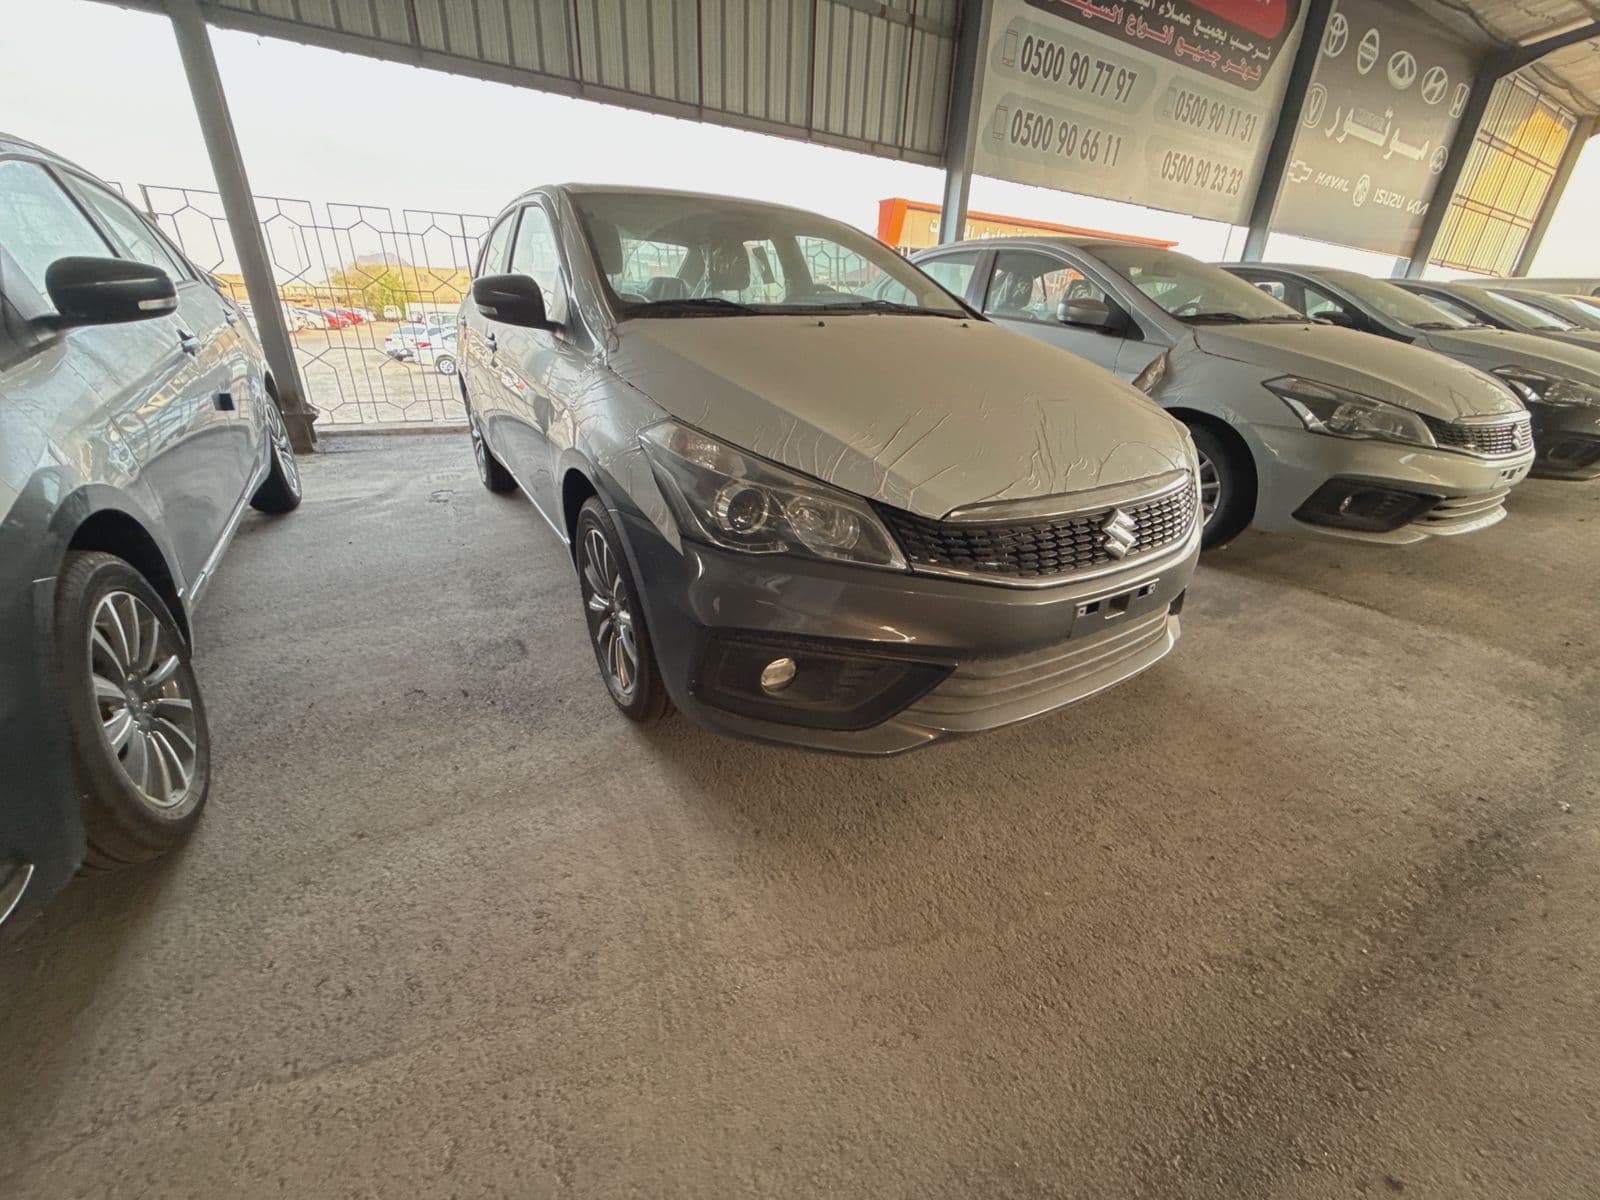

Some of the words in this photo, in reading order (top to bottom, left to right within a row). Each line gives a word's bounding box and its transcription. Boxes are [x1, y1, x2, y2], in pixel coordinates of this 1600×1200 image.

[1021, 35, 1065, 82] 0500
[1068, 51, 1089, 90] 90
[1091, 60, 1116, 96] 77
[1115, 68, 1138, 103] 97
[1175, 36, 1221, 69] جميع
[1175, 90, 1208, 128] 0500
[1208, 102, 1224, 134] 90
[1010, 108, 1054, 151] 0500
[1056, 121, 1078, 157] 90
[1080, 128, 1101, 162] 66
[1103, 134, 1122, 167] 11
[1161, 150, 1194, 185] 0500
[1195, 159, 1210, 188] 90
[1210, 163, 1227, 191] 23
[1373, 187, 1405, 209] ISUZU
